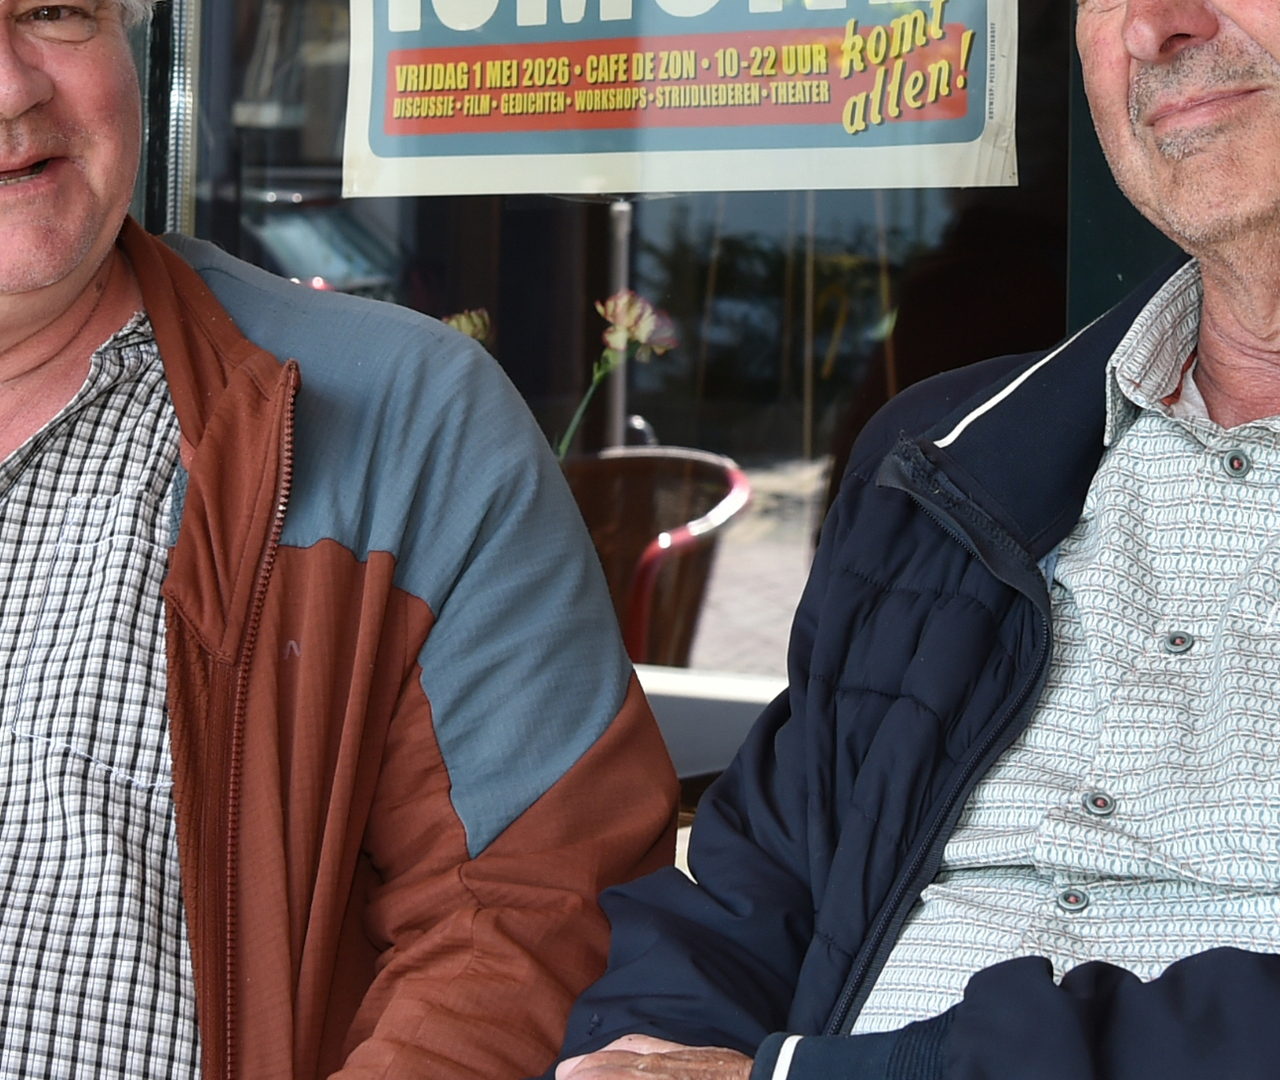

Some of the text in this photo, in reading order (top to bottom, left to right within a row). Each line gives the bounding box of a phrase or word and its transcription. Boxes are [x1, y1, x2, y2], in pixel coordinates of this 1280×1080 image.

[395, 44, 828, 92] VRIJDAG 1 MEI 2026 CAFE DE ZON 10-22 UUR
[842, 30, 975, 135] allen!
[393, 81, 829, 118] DISCUSSIE FILM GEDICHTEN WORKSHOPS STRIJDLIEDEREN THEATER
